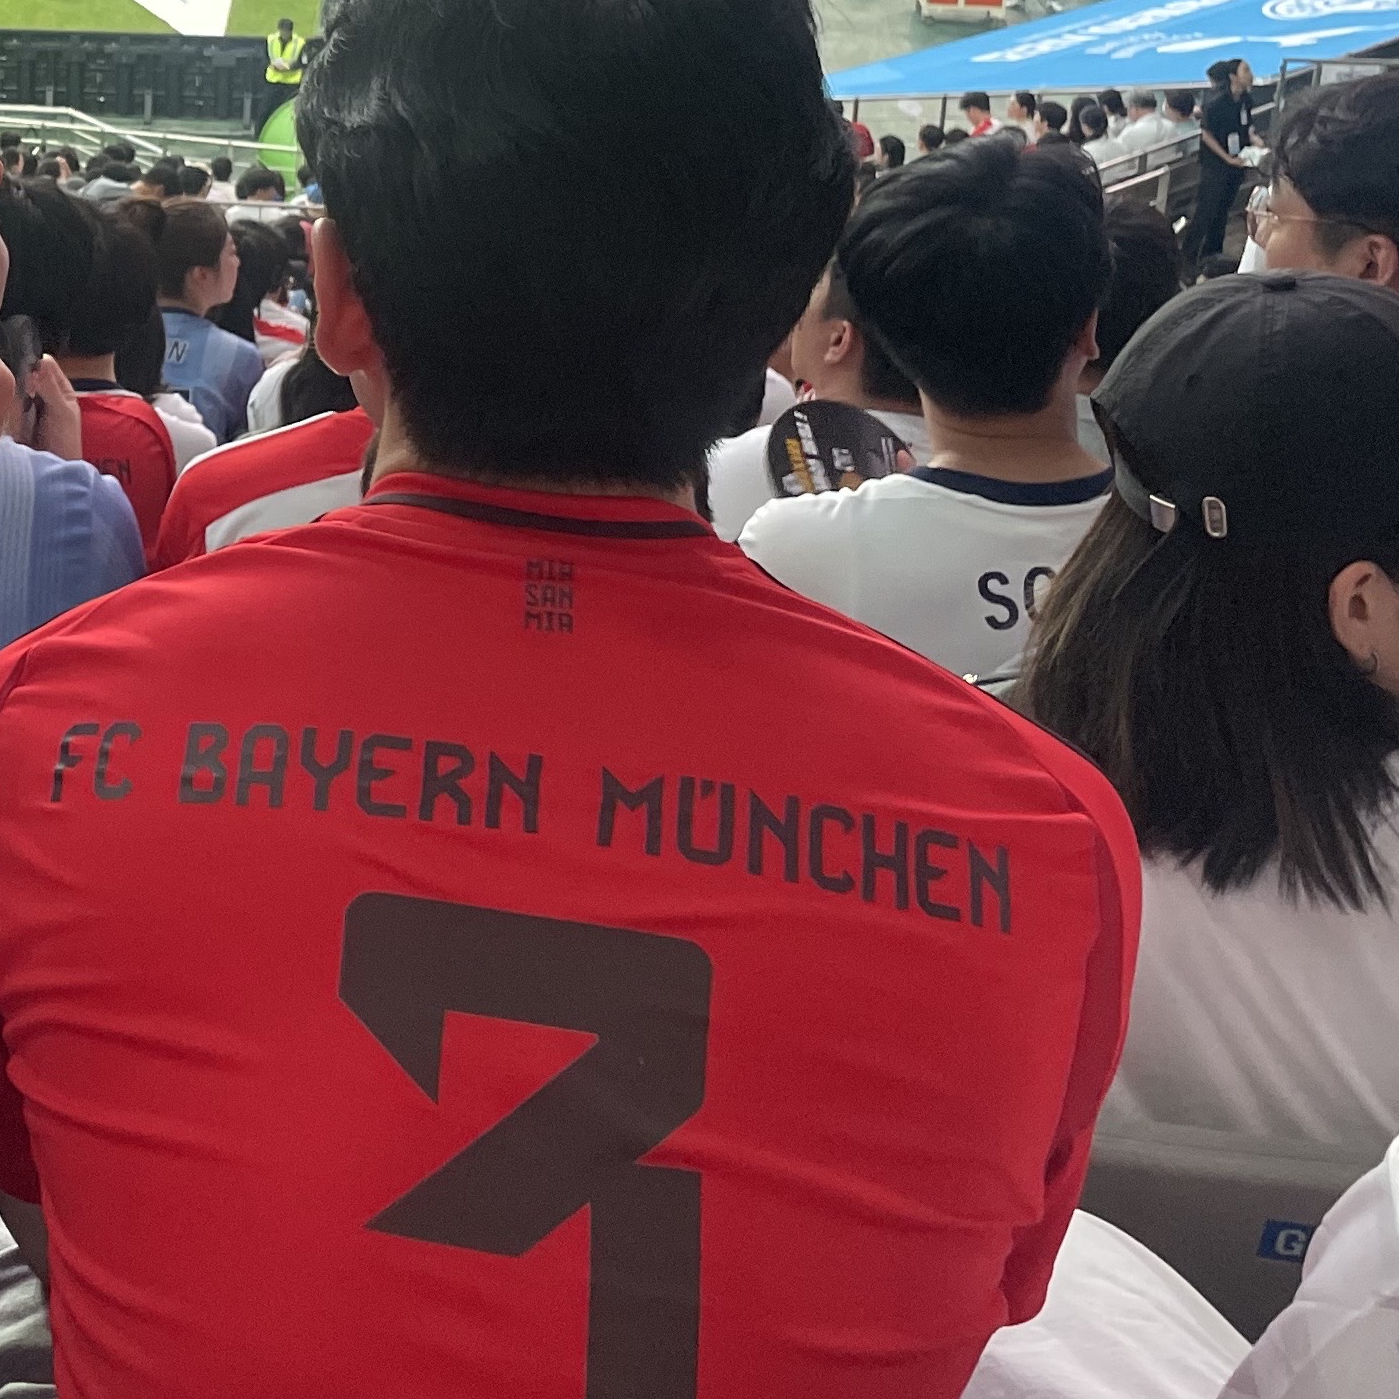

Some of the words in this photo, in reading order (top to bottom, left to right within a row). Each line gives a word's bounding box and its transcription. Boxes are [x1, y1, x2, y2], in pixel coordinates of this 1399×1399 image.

[526, 559, 573, 581] MIA
[525, 582, 573, 608] SAN
[978, 567, 1056, 630] SO
[524, 610, 573, 634] MIA
[51, 721, 142, 803] FC
[178, 722, 543, 834] BAYERN
[597, 766, 1012, 935] MÜNCHEN
